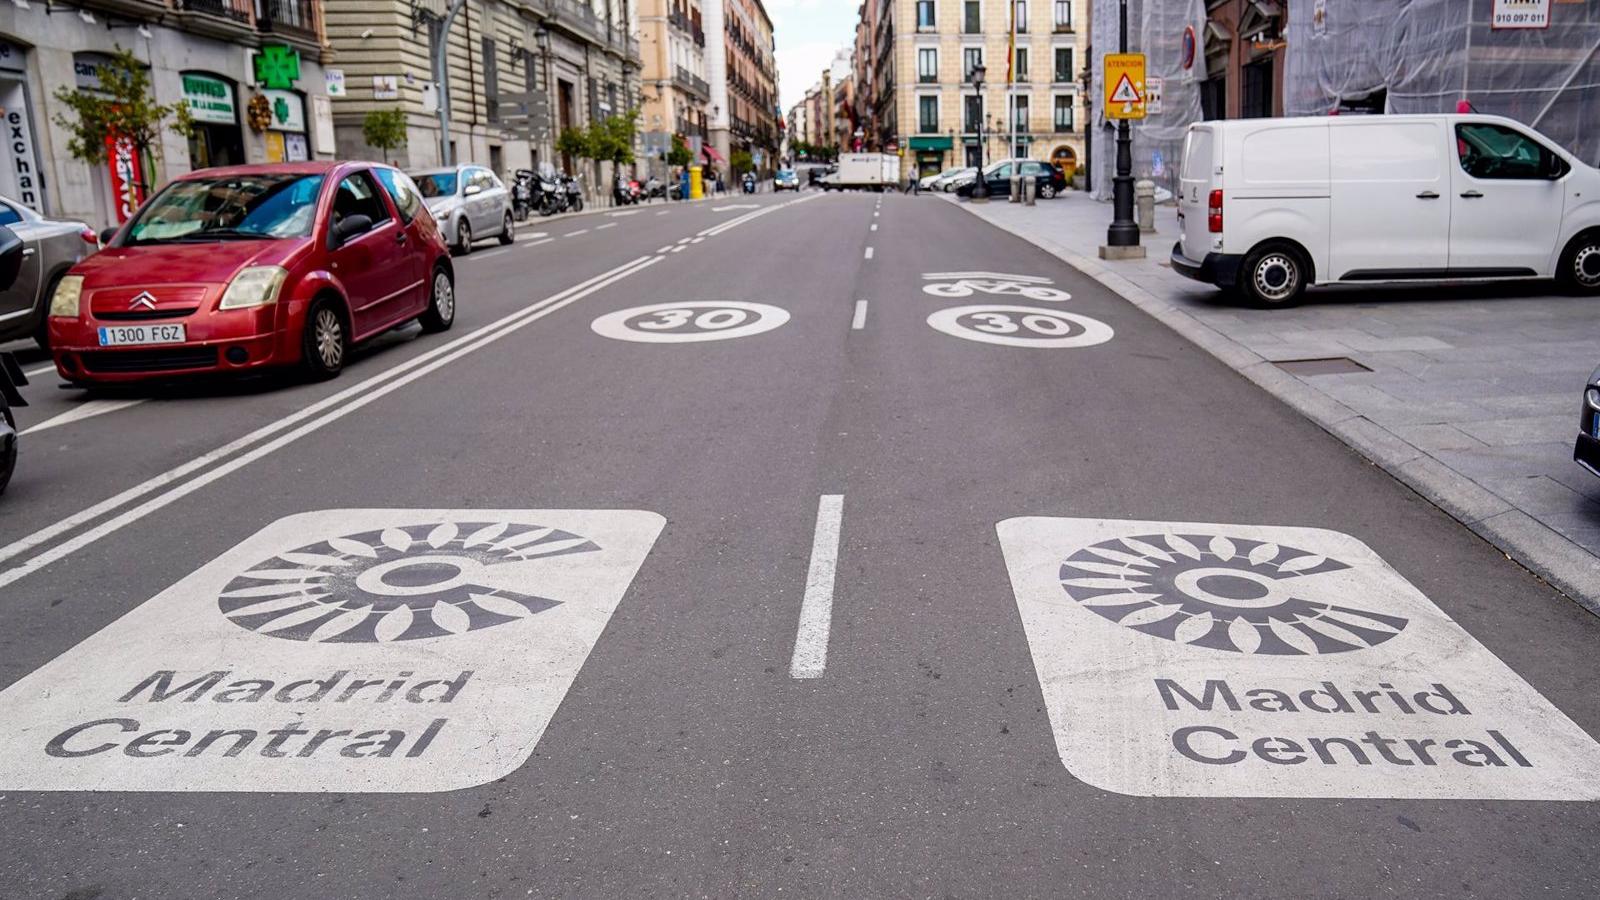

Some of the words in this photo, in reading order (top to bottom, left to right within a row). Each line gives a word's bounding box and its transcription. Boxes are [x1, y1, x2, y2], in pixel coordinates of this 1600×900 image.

[1513, 14, 1528, 22] 097
[1531, 14, 1545, 22] 011
[638, 309, 747, 329] 30
[971, 313, 1070, 335] 30
[110, 328, 145, 343] 1300
[151, 326, 180, 340] FGZ
[118, 670, 475, 703] Madrid
[1154, 678, 1472, 715] Madrid
[44, 717, 448, 758] Central
[1172, 725, 1534, 767] Central
